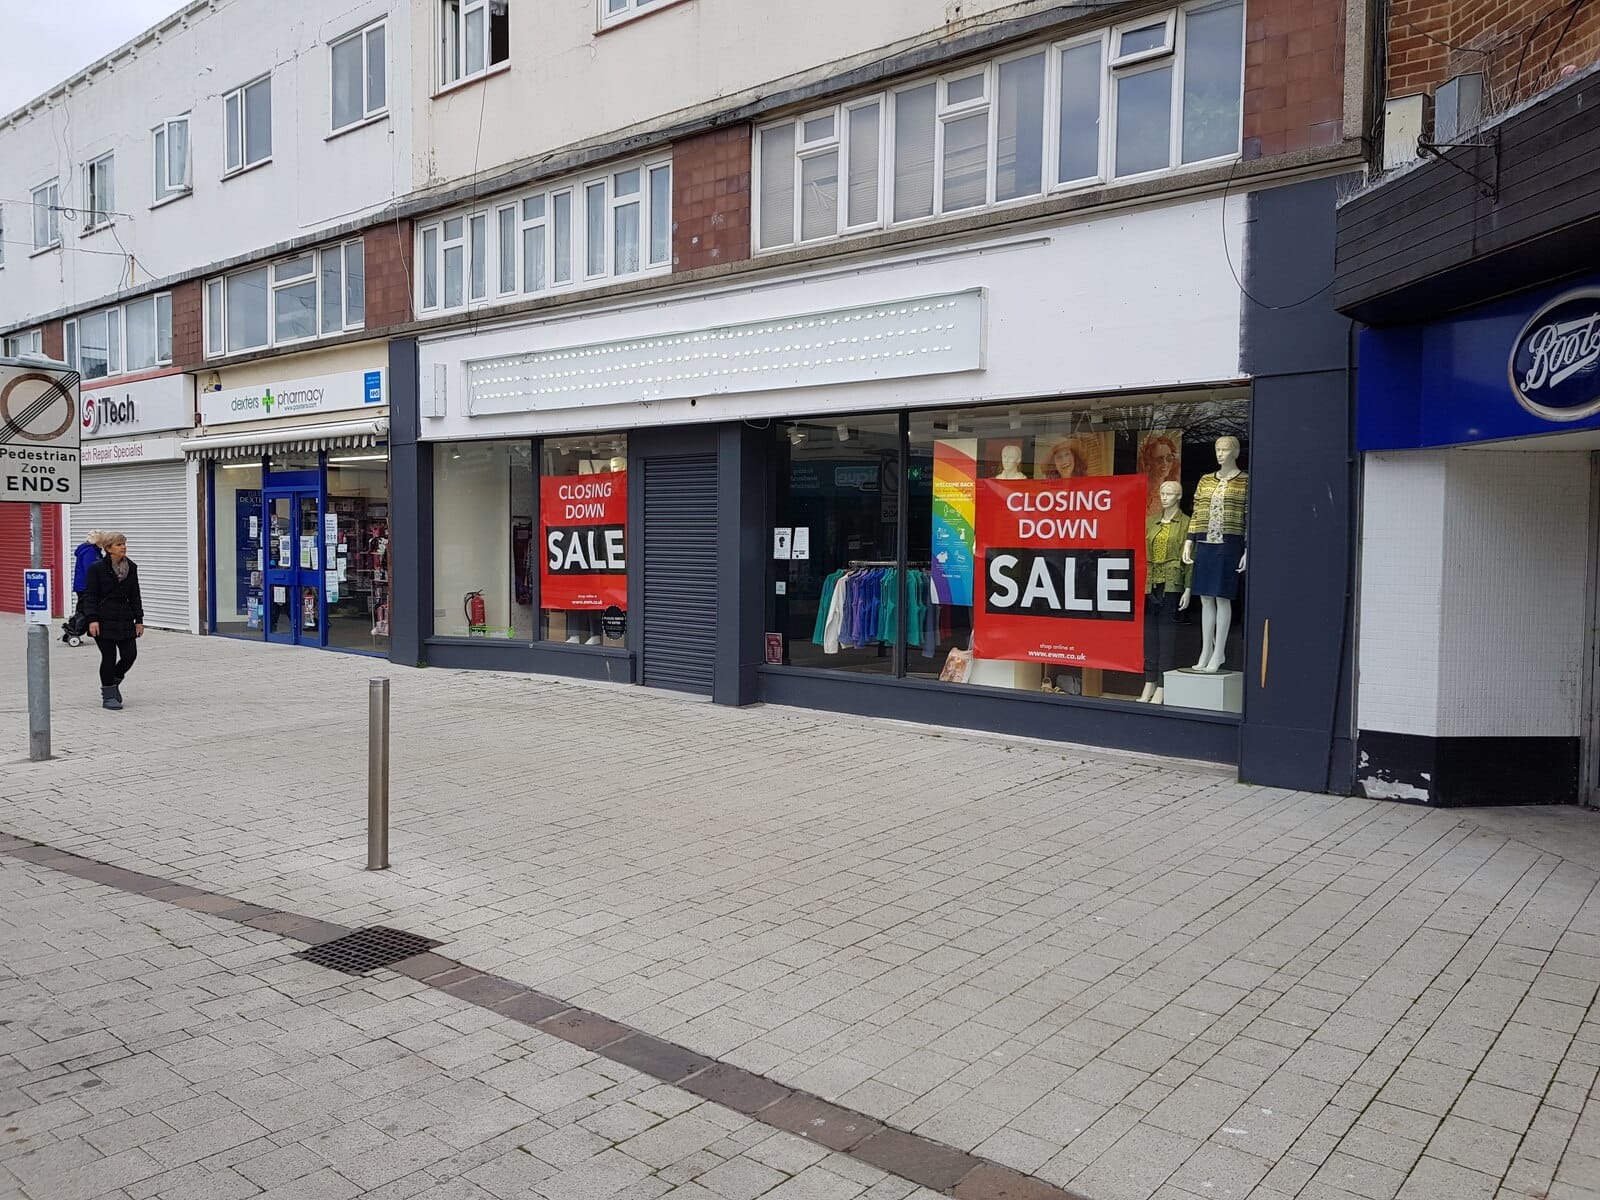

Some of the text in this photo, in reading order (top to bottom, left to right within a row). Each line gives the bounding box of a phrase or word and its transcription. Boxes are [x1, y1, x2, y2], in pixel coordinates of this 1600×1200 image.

[231, 387, 324, 411] dexters pharmacy
[98, 394, 135, 425] iTech
[0, 448, 76, 462] Pedestrian
[81, 444, 143, 462] ech Repair Specialist
[21, 463, 56, 474] Zone
[6, 476, 70, 493] ENDS
[558, 482, 612, 500] CLOSING
[1006, 490, 1112, 512] CLOSING
[565, 503, 605, 519] DOWN
[1018, 519, 1098, 539] DOWN
[548, 530, 626, 570] SALE
[989, 554, 1131, 613] SALE
[1028, 650, 1087, 660] www.ewm.co.uk
